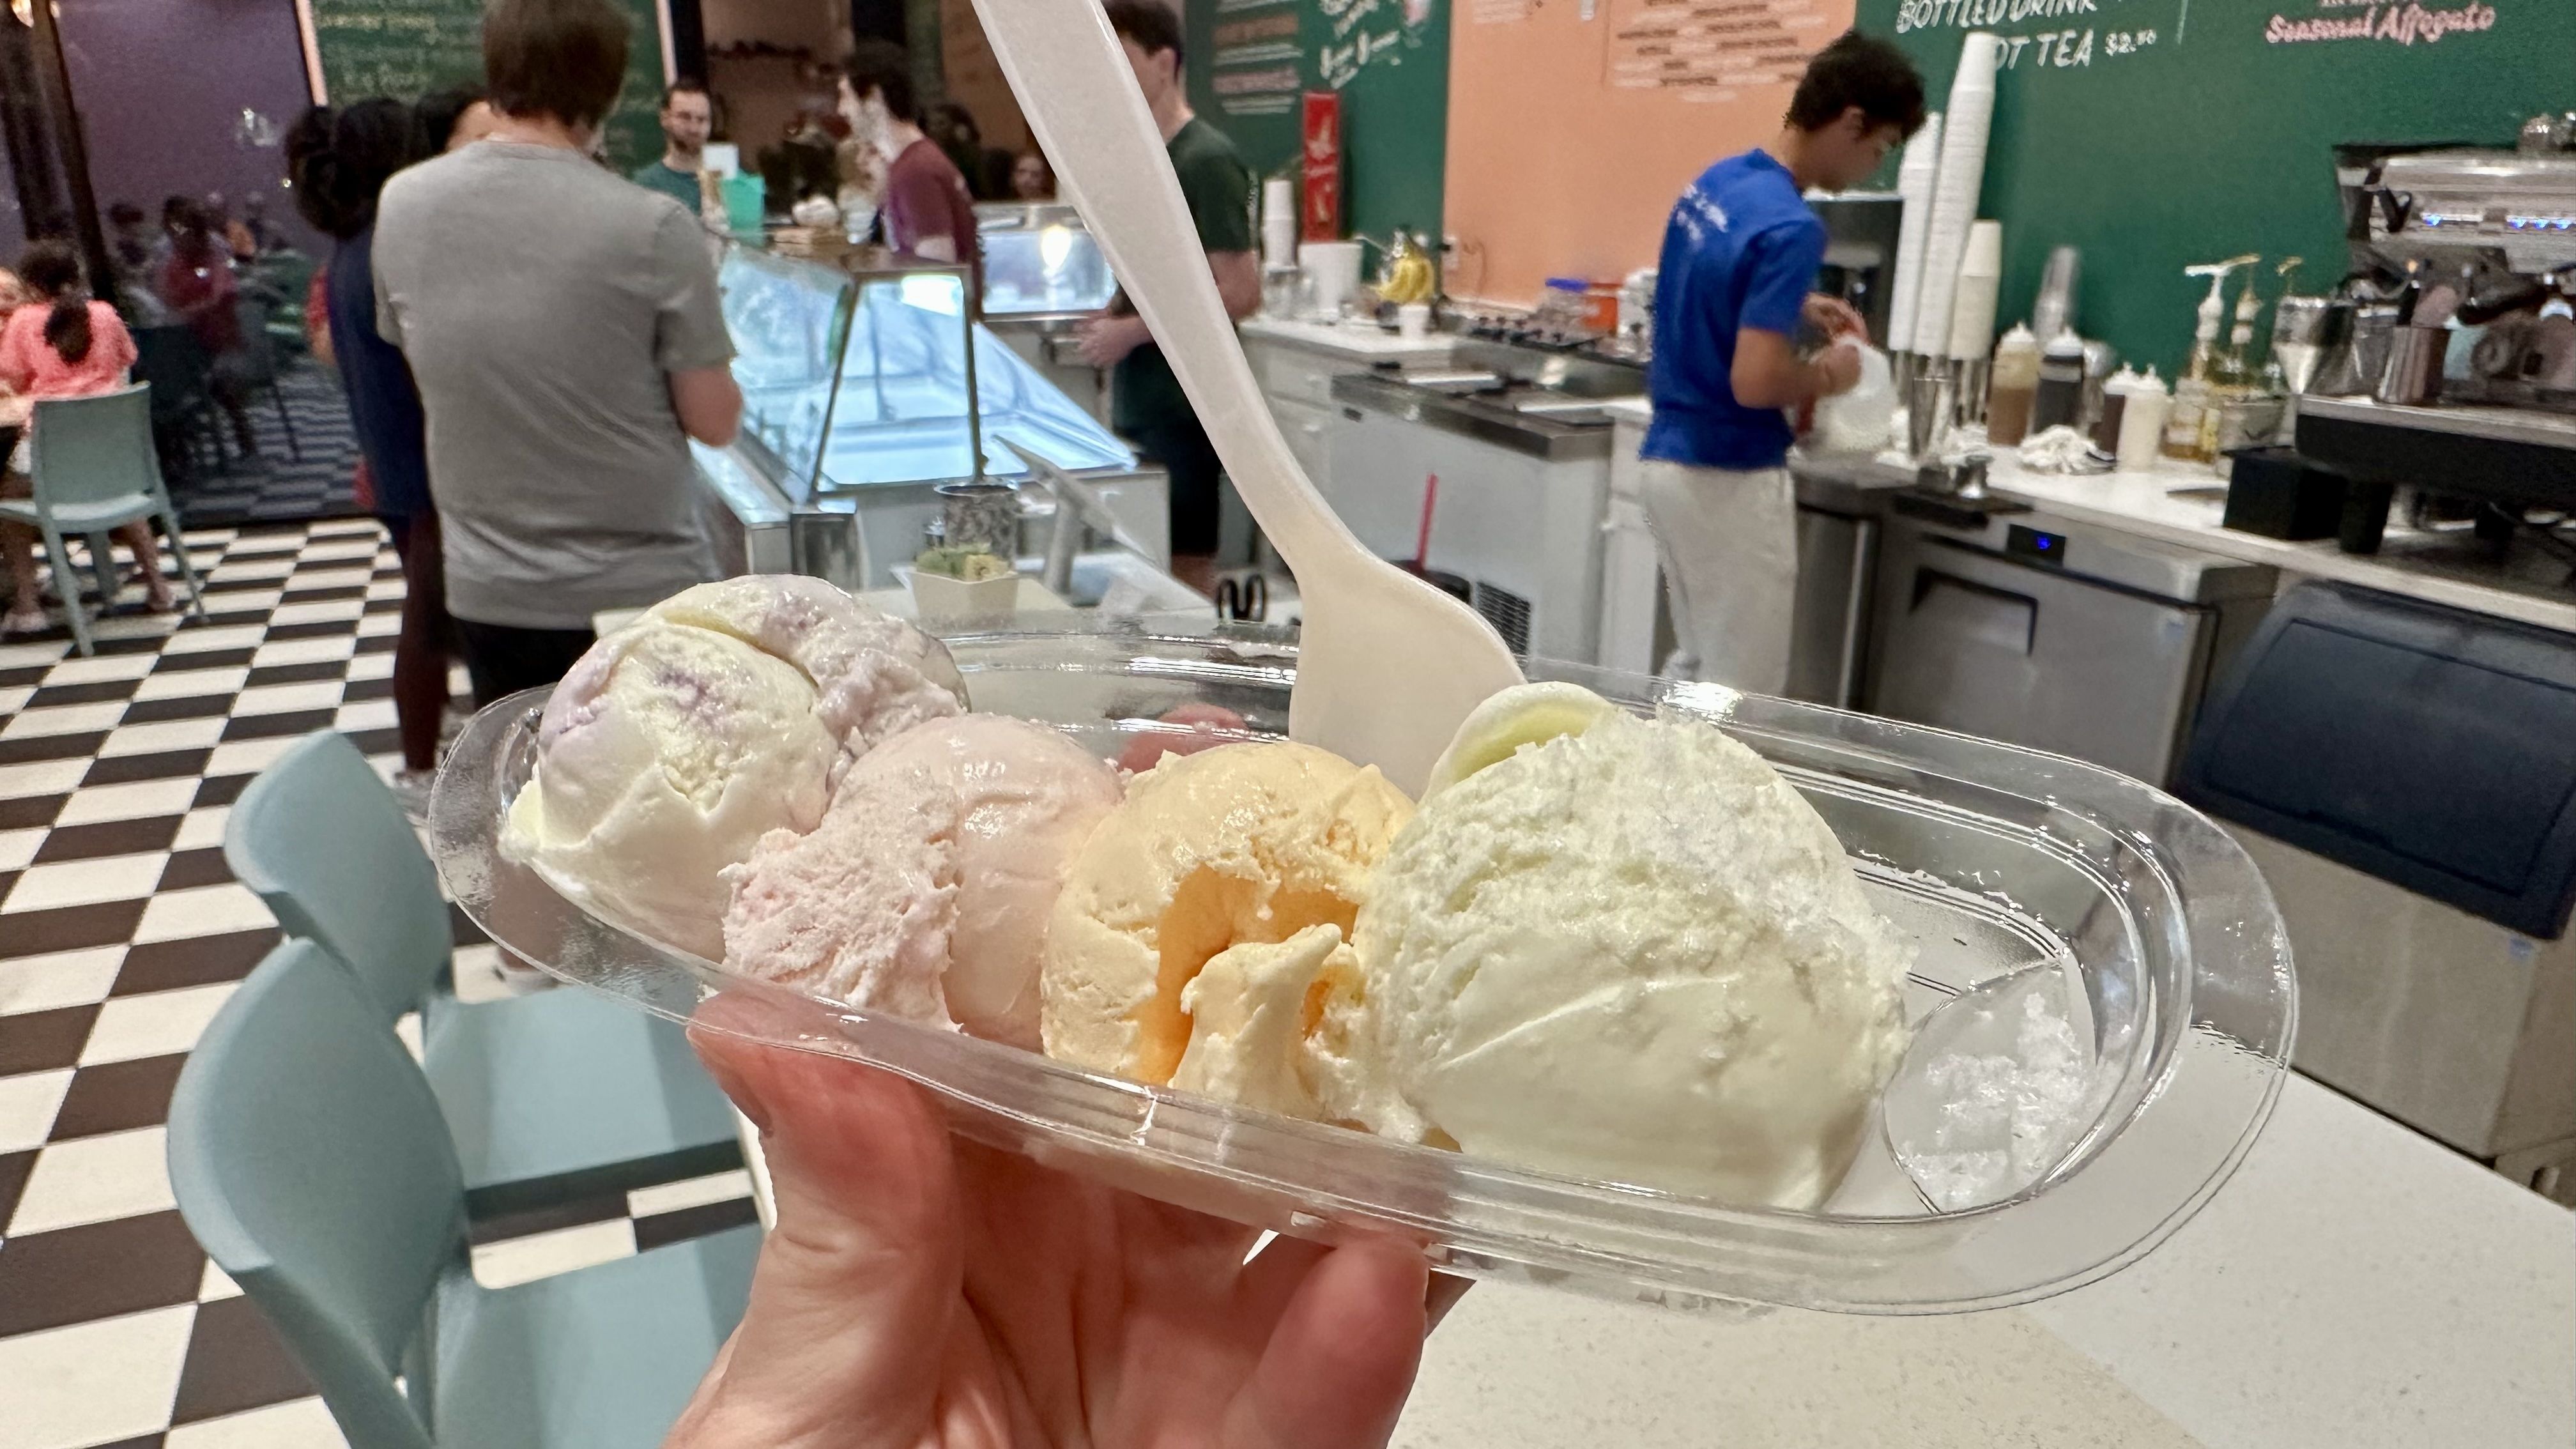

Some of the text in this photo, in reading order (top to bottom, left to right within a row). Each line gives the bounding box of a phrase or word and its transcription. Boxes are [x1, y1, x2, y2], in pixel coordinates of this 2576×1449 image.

[1896, 0, 2007, 34] BOTTLED
[2374, 1, 2496, 46] Affogato
[1996, 35, 2030, 70] OT
[2036, 29, 2094, 67] TEA
